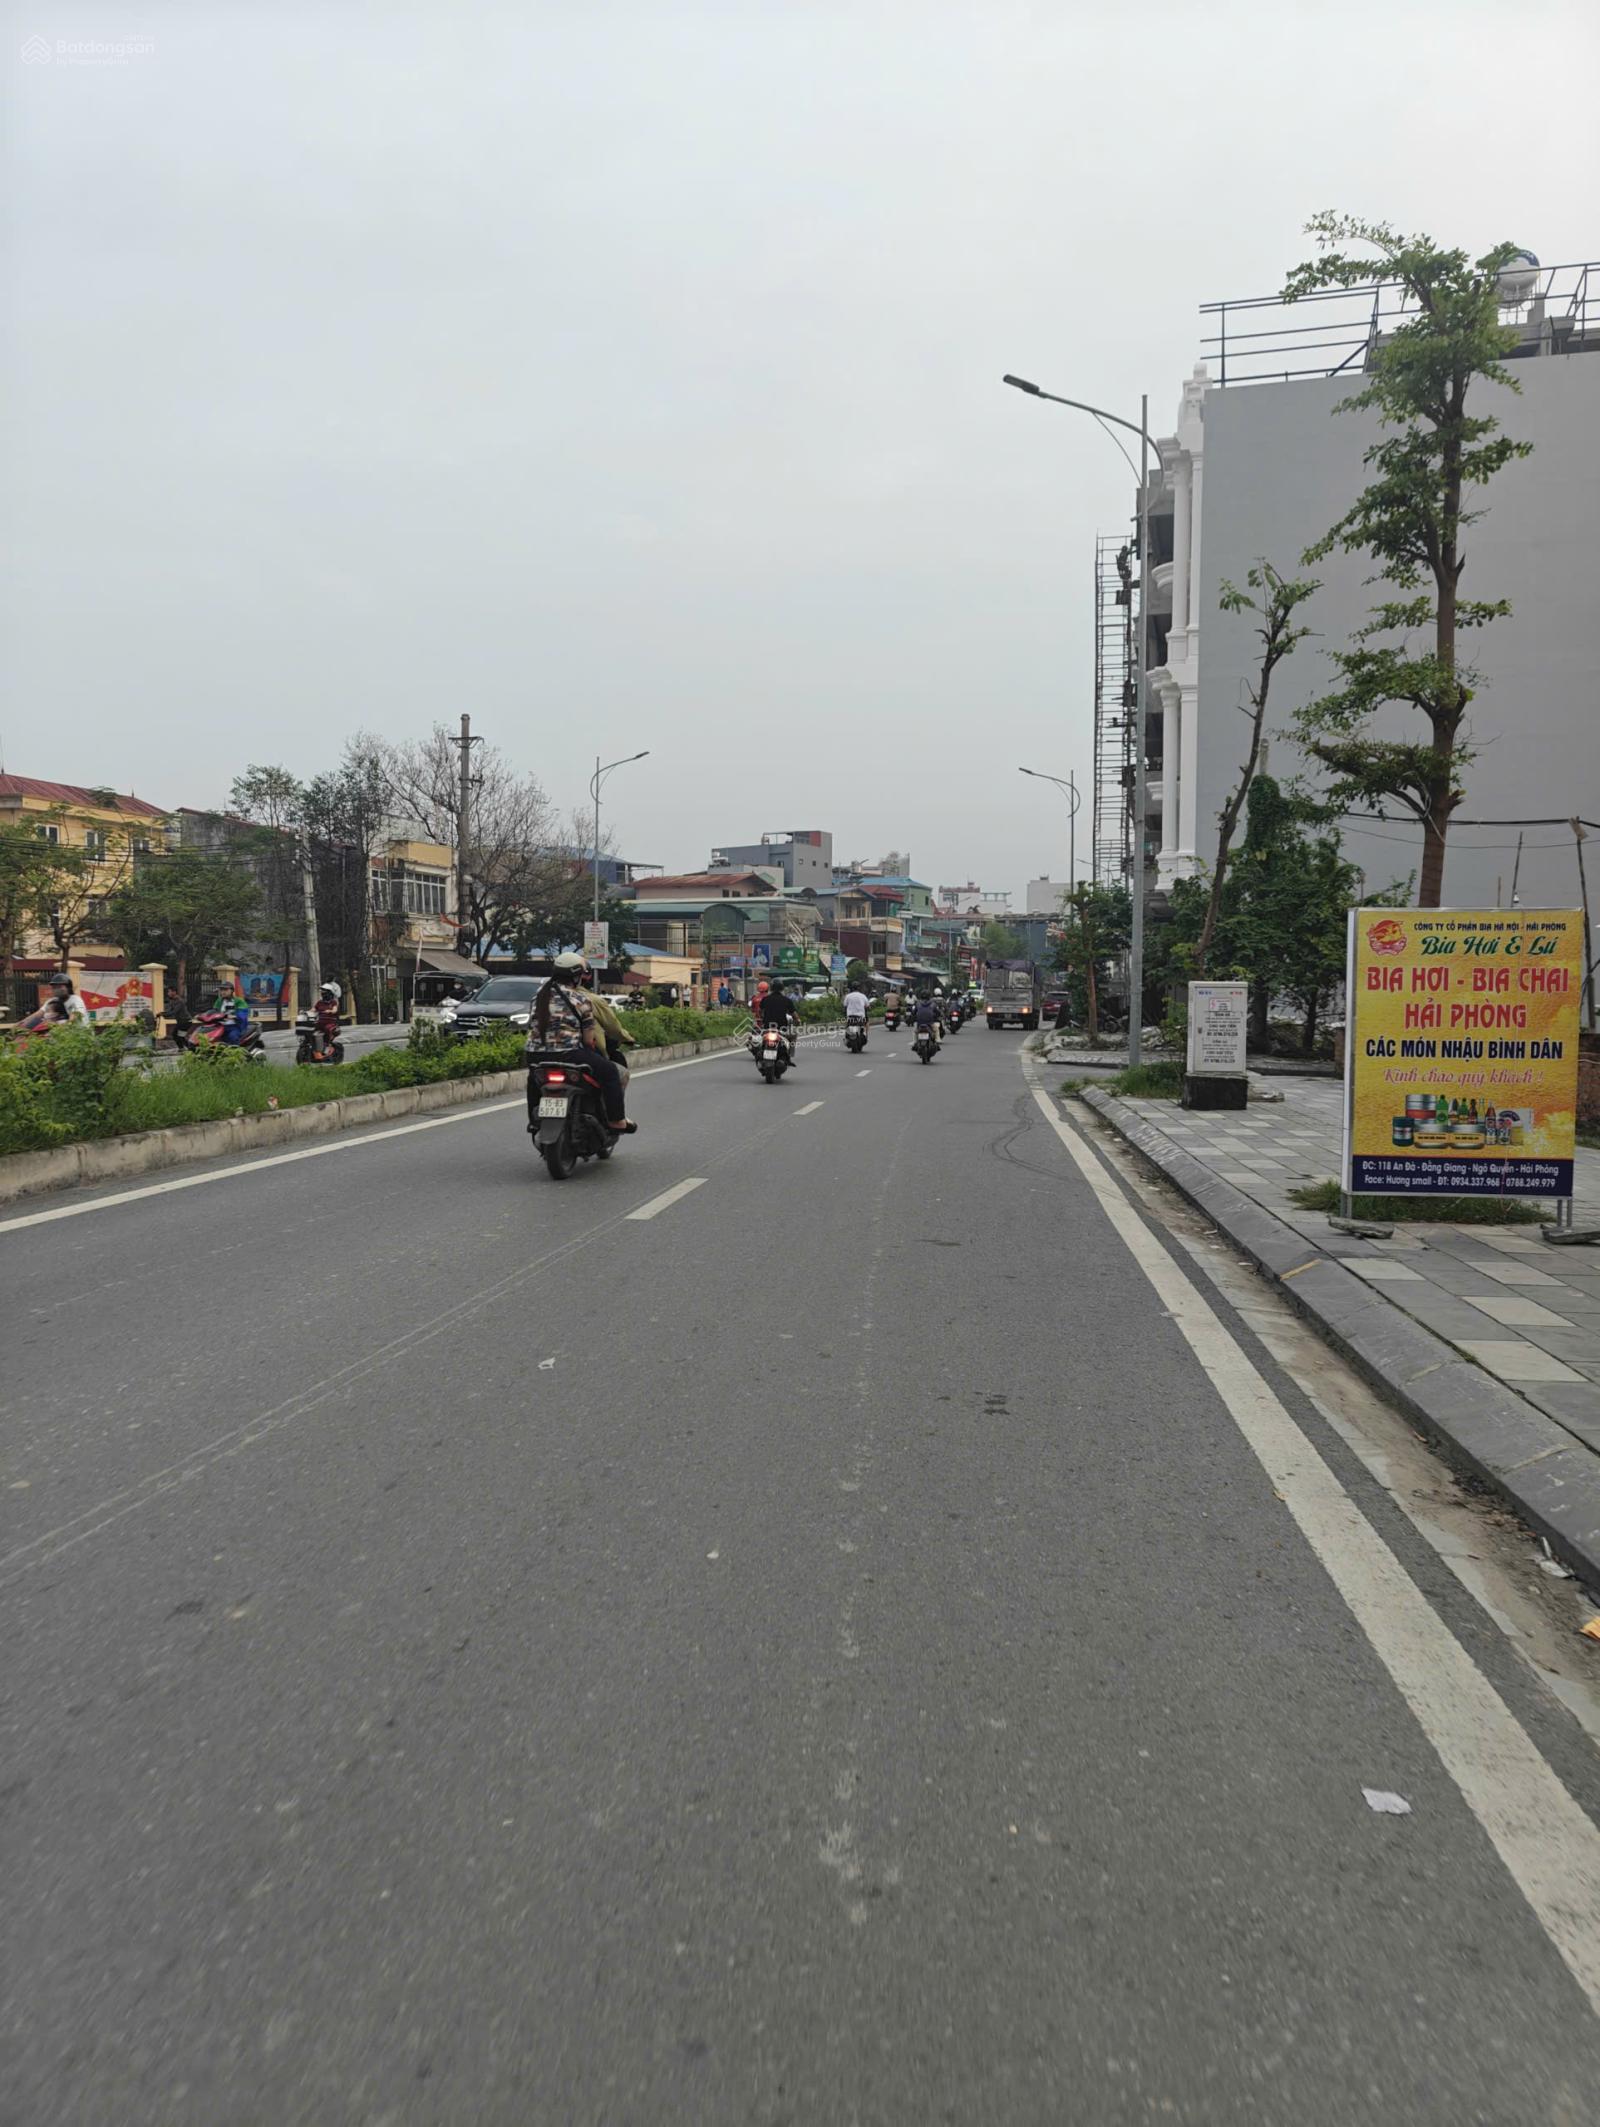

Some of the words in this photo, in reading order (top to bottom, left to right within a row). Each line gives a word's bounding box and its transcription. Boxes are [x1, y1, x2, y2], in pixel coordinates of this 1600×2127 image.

[1435, 923, 1444, 931] TY
[1479, 923, 1492, 931] BIA
[1421, 936, 1455, 956] Bia
[1463, 936, 1501, 956] Hơi
[1367, 967, 1404, 993] BIA
[1412, 966, 1450, 993] HƠI
[1472, 967, 1510, 993] BIA
[1519, 967, 1568, 994] CHAI
[1405, 997, 1442, 1029] HẢI
[1450, 998, 1526, 1030] PHÒNG
[1366, 1036, 1396, 1058] CÁC
[1401, 1037, 1436, 1058] MÓN
[1441, 1037, 1484, 1062] NHẬU
[1488, 1037, 1525, 1059] BÌNH
[1530, 1037, 1562, 1059] DÂN
[1378, 1161, 1391, 1170] 118
[1393, 1162, 1403, 1170] An
[1444, 1162, 1466, 1175] Giang
[1364, 1175, 1384, 1184] Face:
[1412, 1176, 1432, 1185] small
